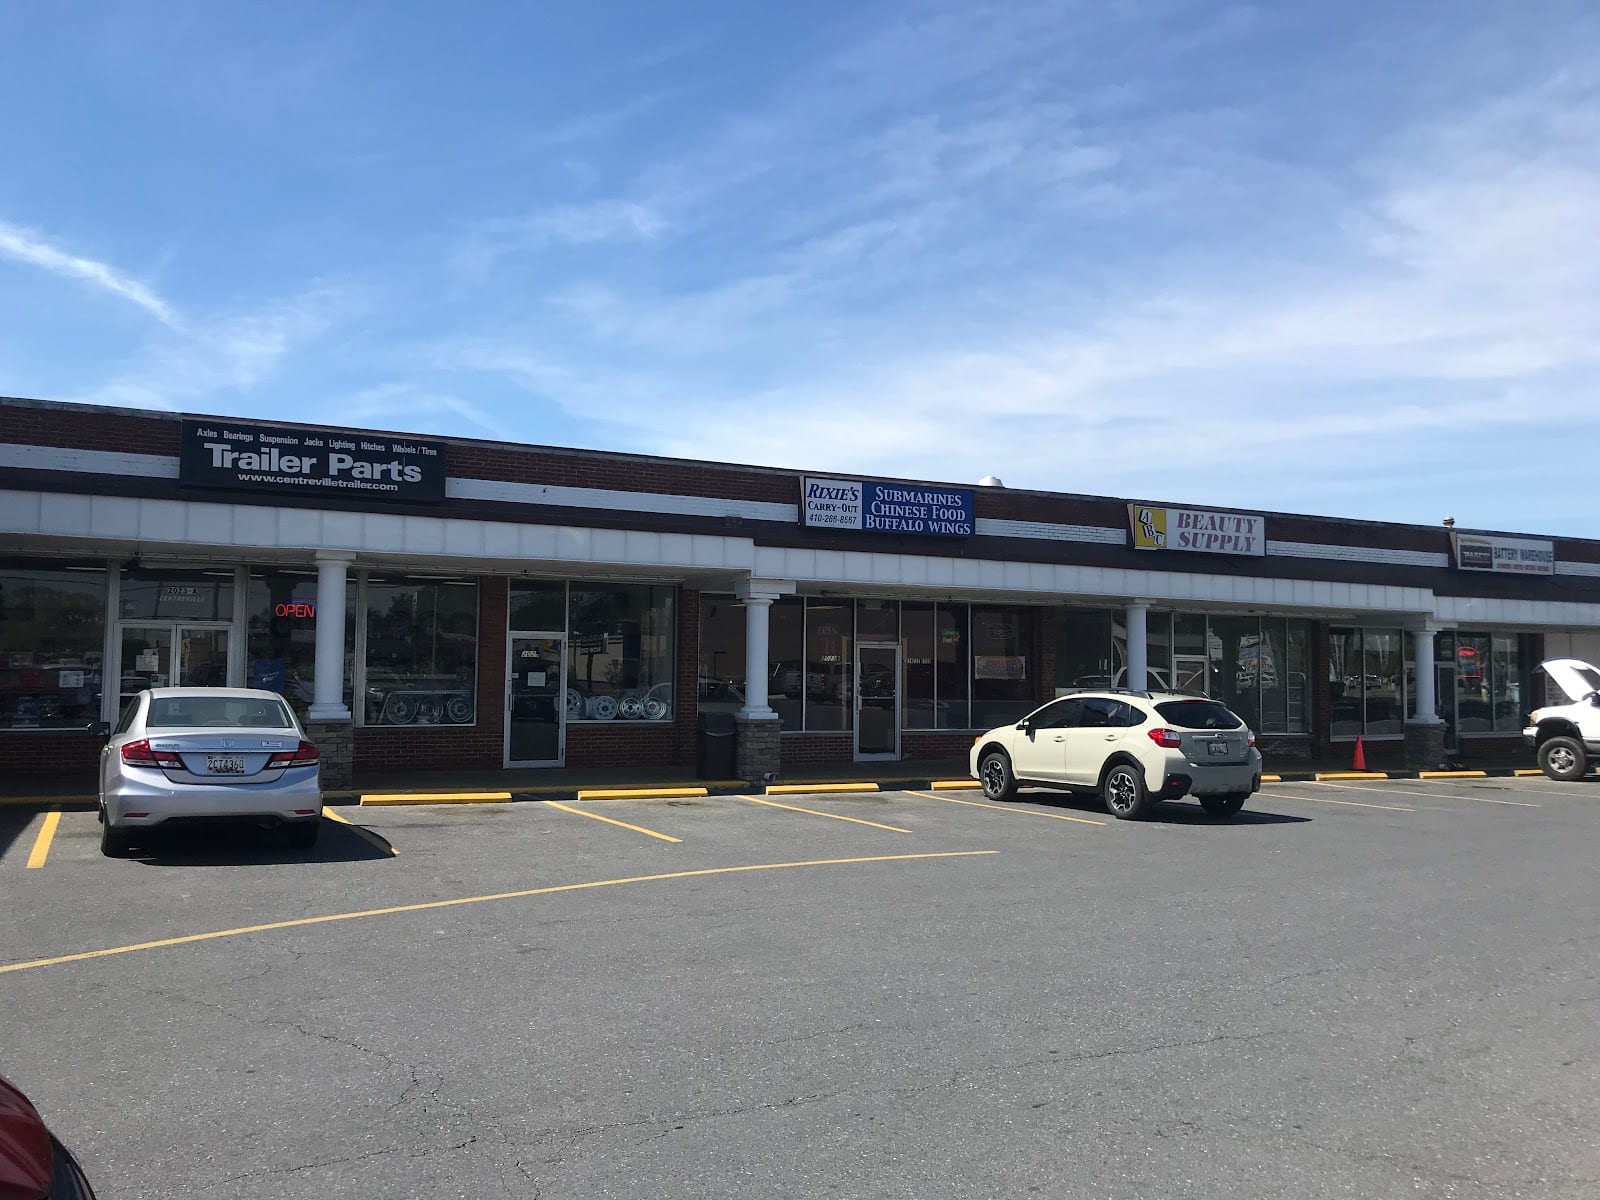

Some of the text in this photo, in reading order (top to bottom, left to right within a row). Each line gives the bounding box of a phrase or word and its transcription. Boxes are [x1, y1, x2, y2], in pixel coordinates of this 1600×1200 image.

[196, 428, 218, 439] Axles
[223, 430, 254, 443] Bearings
[259, 433, 299, 445] Suspension
[303, 437, 324, 447] Jacks
[328, 439, 356, 451] Lighting
[360, 441, 385, 452] Hitches
[203, 442, 423, 483] Trailer Parts
[237, 473, 399, 491] www.centrevilletrailer.com
[807, 483, 860, 501] RIXIE'S
[807, 500, 859, 513] CARRY-OUT
[875, 486, 962, 507] SUBMARINES
[871, 501, 966, 521] CHINESE FOOD
[865, 514, 971, 535] BUFFALO WINGS
[1177, 512, 1257, 534] BEAUTY
[1178, 531, 1256, 552] SUPPLY
[275, 603, 315, 617] OPEN
